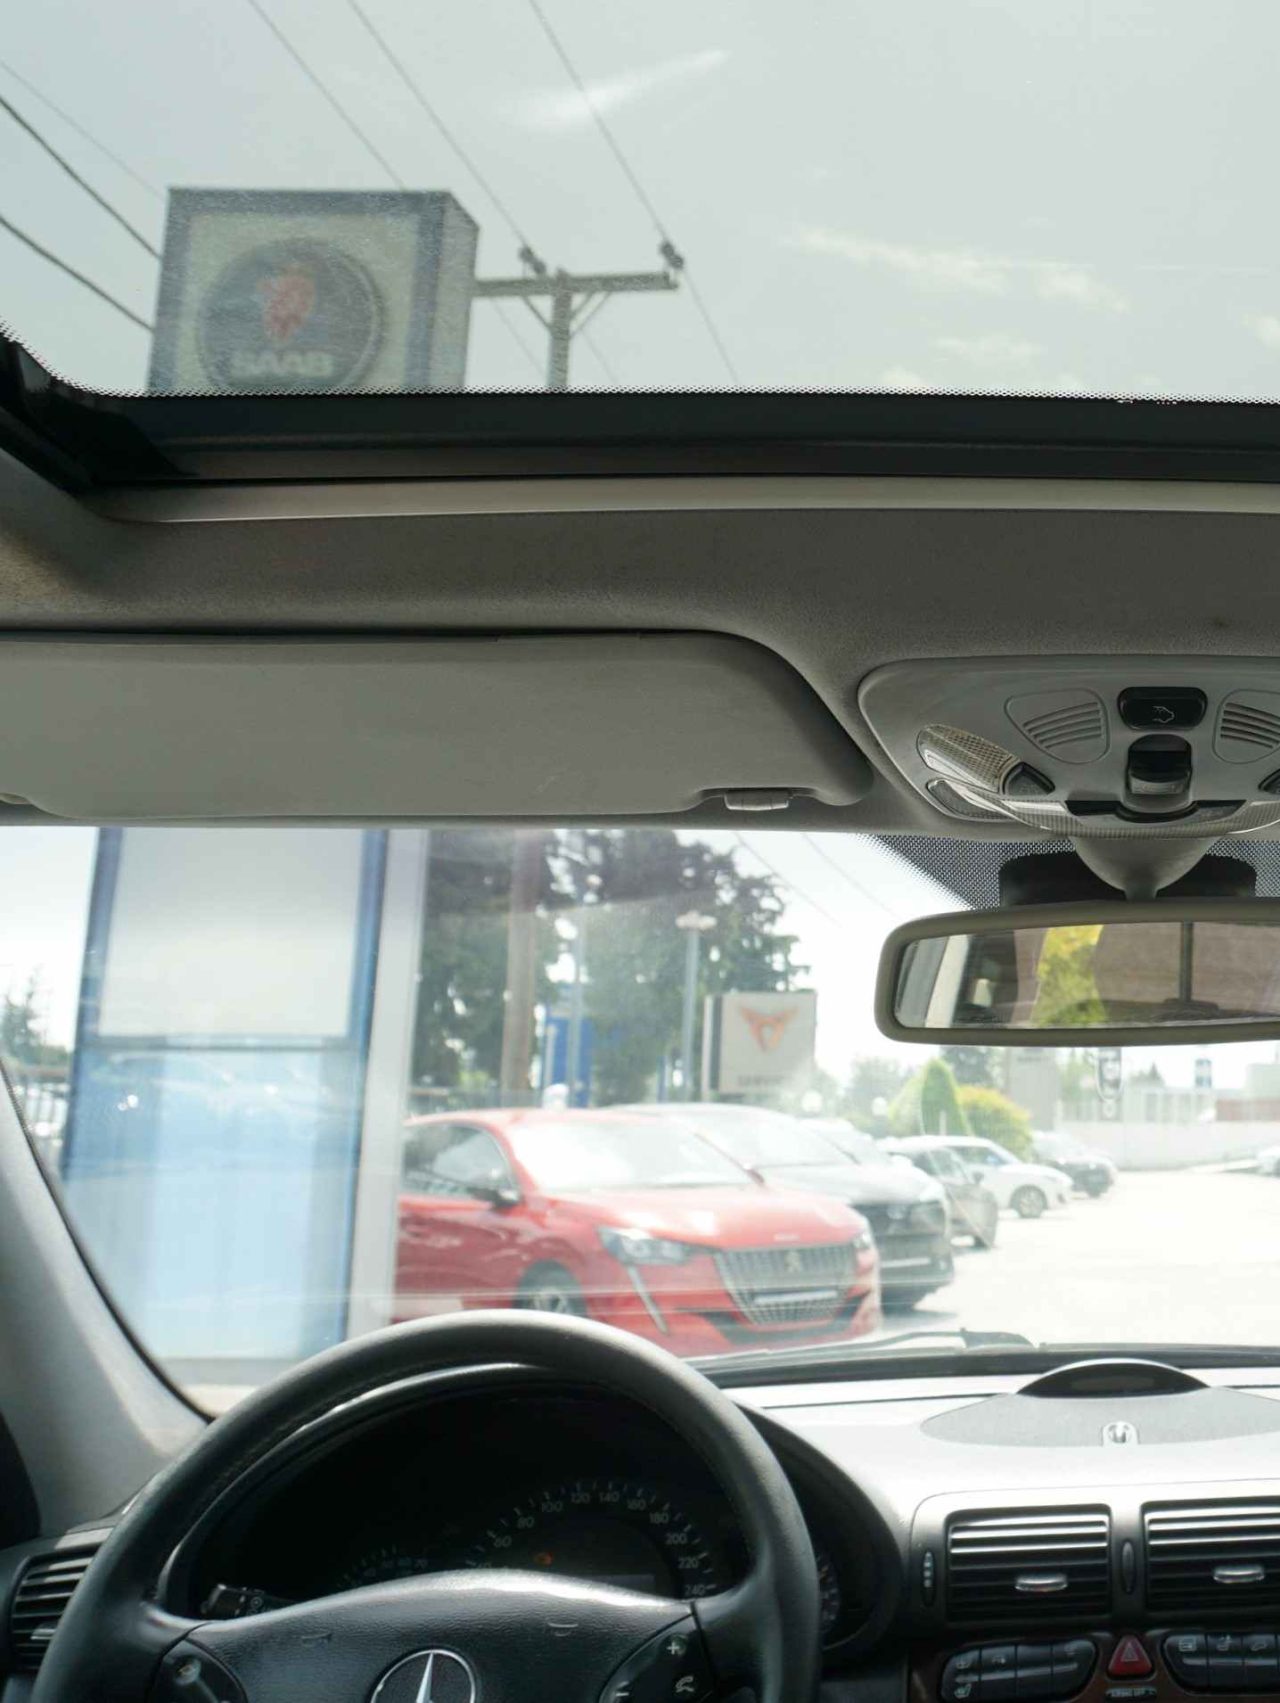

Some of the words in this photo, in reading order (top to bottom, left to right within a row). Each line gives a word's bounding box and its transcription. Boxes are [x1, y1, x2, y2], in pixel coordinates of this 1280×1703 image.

[570, 1492, 591, 1504] 120
[600, 1491, 620, 1503] 140
[541, 1501, 563, 1513] 100
[627, 1500, 647, 1511] 160
[516, 1516, 535, 1529] 80
[650, 1512, 670, 1524] 180
[493, 1536, 512, 1548] 60
[665, 1533, 688, 1545] 200
[678, 1557, 699, 1569] 220
[685, 1584, 705, 1597] 240
